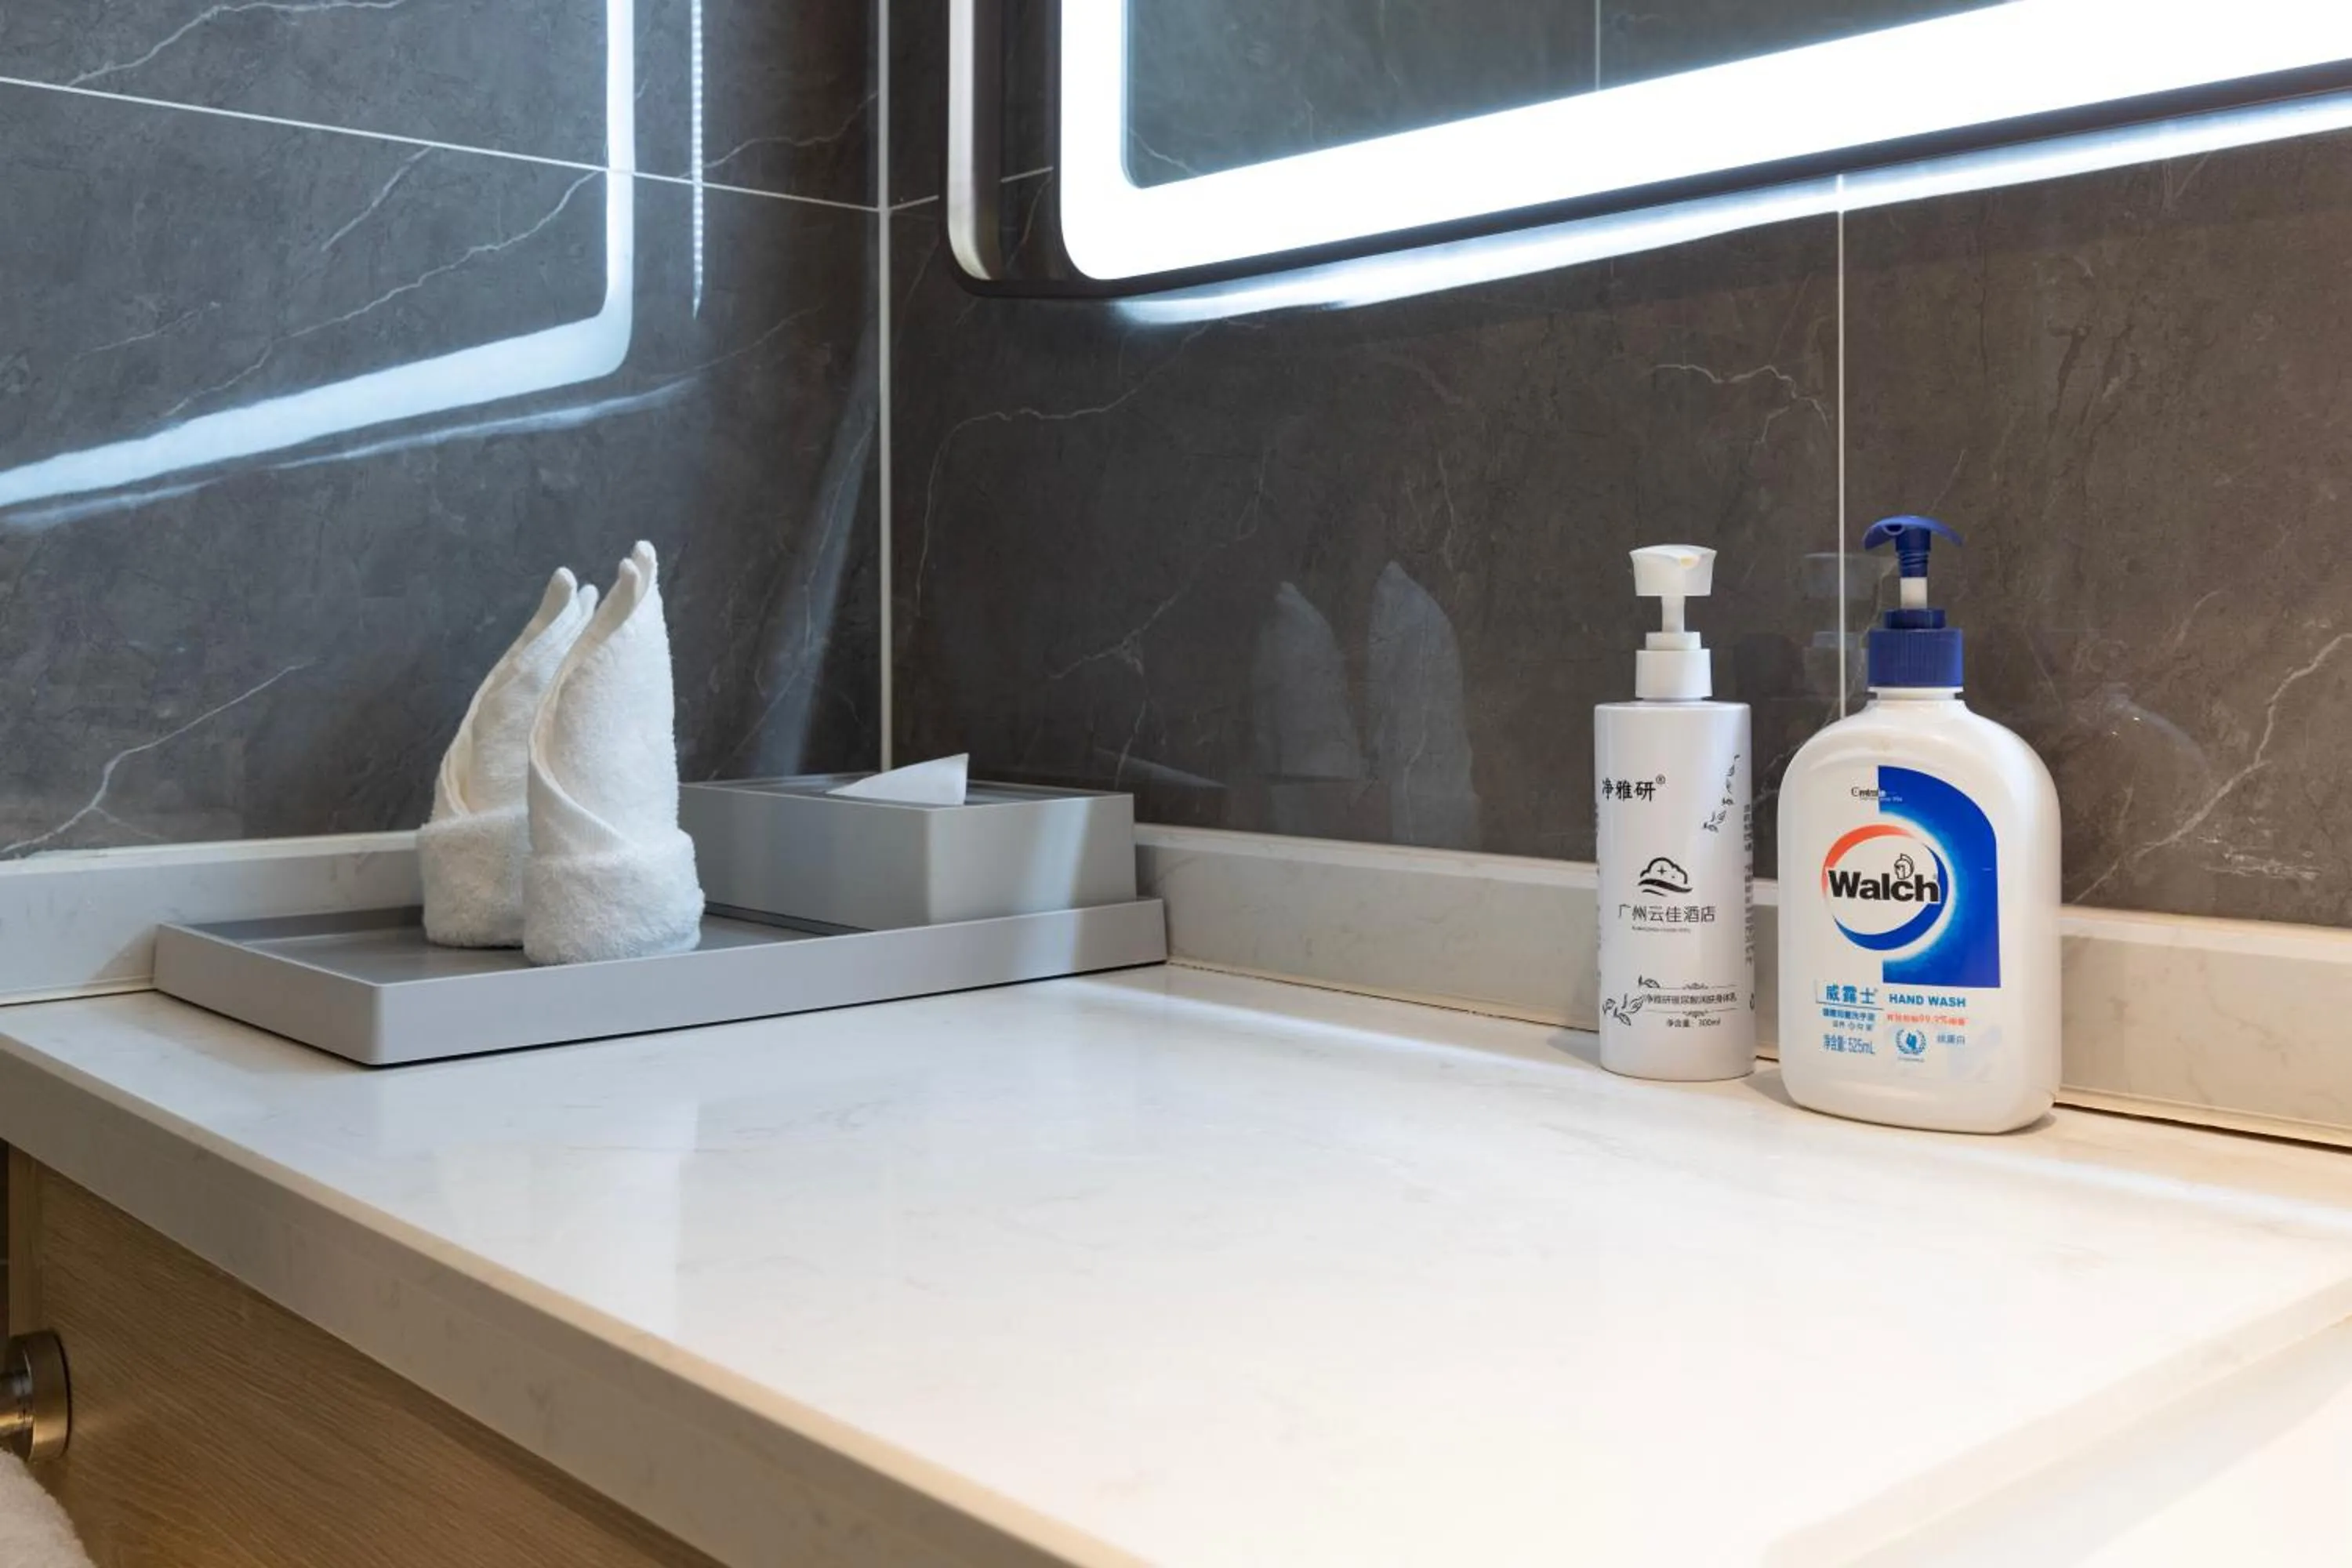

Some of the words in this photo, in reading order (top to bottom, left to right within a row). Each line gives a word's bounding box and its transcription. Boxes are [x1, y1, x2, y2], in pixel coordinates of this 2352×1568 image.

[1828, 870, 1939, 902] Walch
[1618, 904, 1715, 923] 广州云佳酒店
[1826, 983, 1875, 1004] 威露士
[1889, 993, 1924, 1006] HAND
[1929, 996, 1966, 1007] WASH
